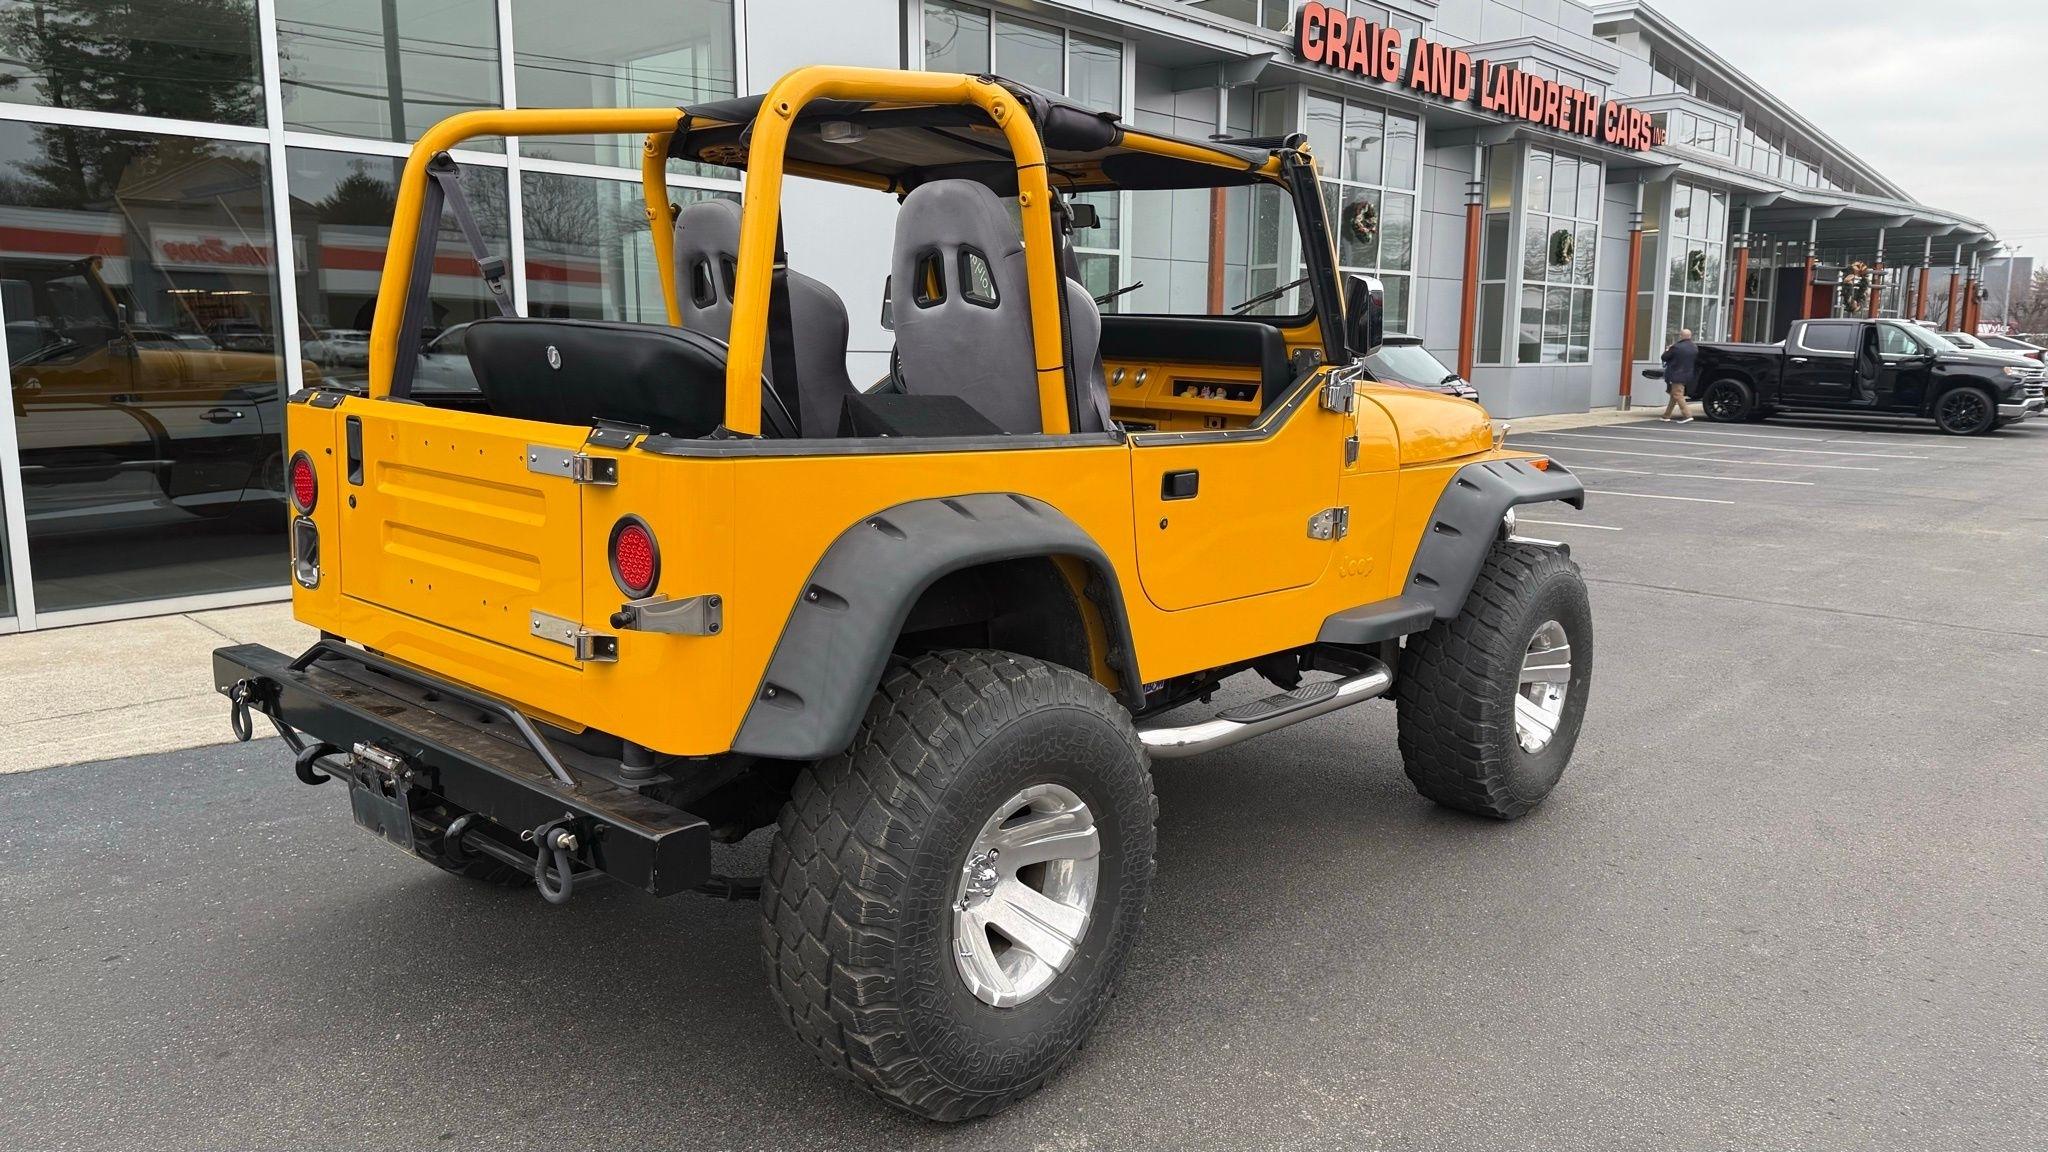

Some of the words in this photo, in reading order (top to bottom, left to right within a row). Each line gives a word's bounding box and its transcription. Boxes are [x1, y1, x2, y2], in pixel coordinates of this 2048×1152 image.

[1300, 1, 1401, 83] CRAIG
[1409, 37, 1472, 101] AND
[1481, 59, 1599, 138] LANDRETH
[1604, 100, 1652, 151] CARS
